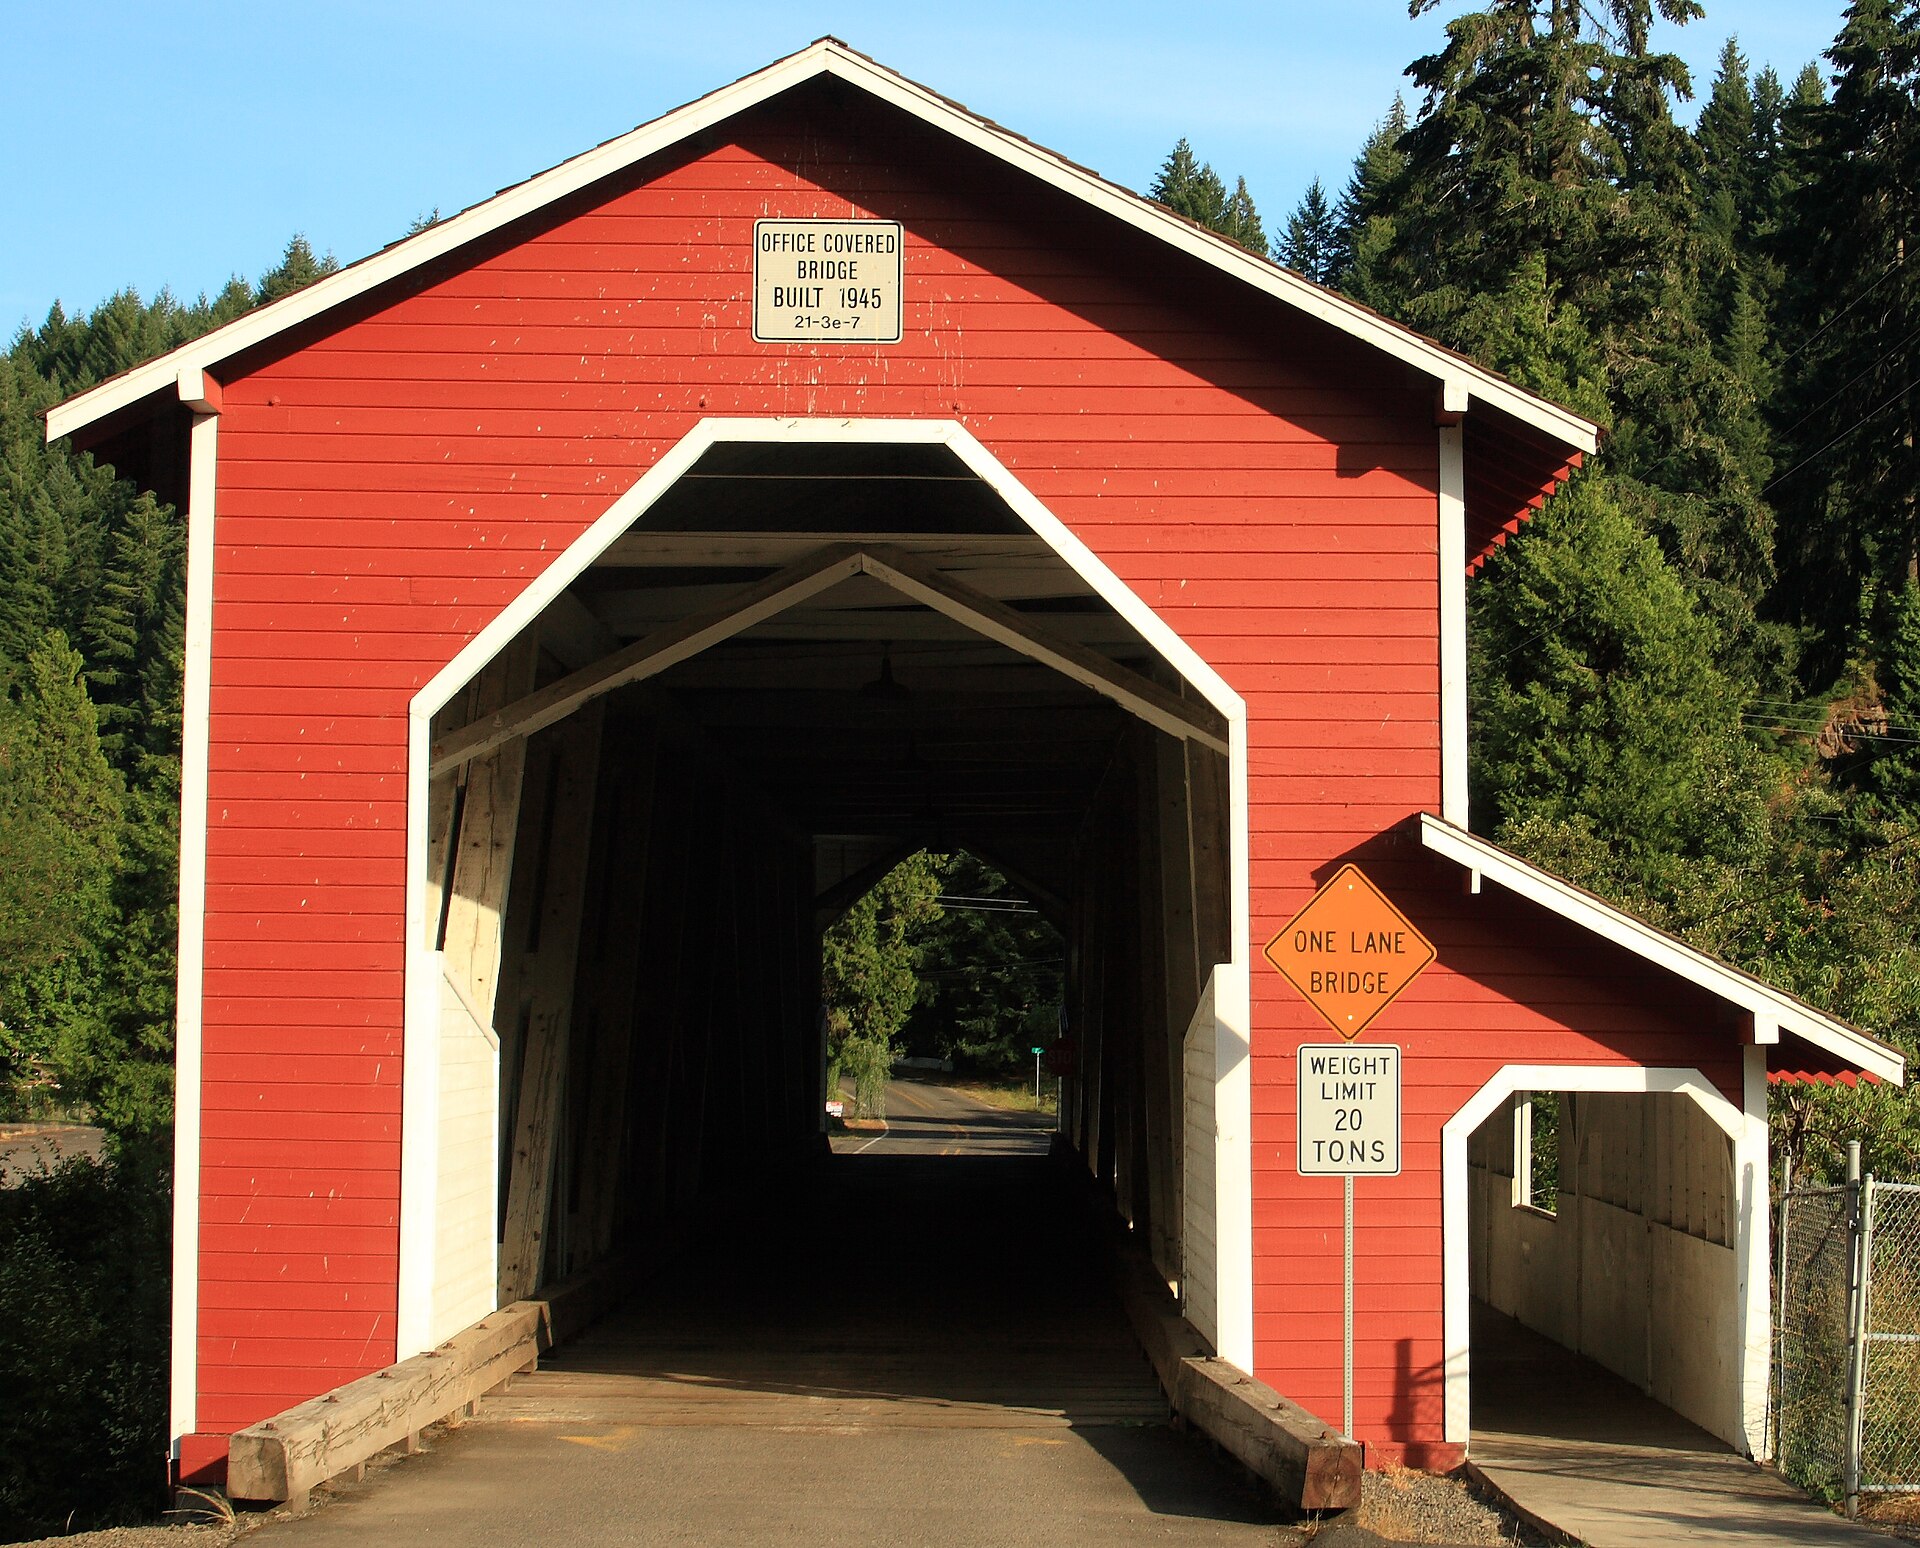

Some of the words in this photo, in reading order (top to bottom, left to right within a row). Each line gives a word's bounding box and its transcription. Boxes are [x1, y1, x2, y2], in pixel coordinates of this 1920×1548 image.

[762, 232, 816, 253] OFFICE
[823, 233, 896, 254] COVERED
[797, 260, 858, 280] BRIDGE
[773, 286, 824, 308] BUILT
[839, 287, 882, 309] 1945
[794, 315, 861, 330] 21-3e-7
[1294, 930, 1337, 953] ONE
[1350, 931, 1406, 954] LANE
[1310, 971, 1389, 994] BRIDGE
[1310, 1056, 1391, 1075] WEIGHT
[1321, 1082, 1377, 1101] LIMIT
[1334, 1108, 1363, 1131] 20
[1312, 1140, 1385, 1163] TONS
